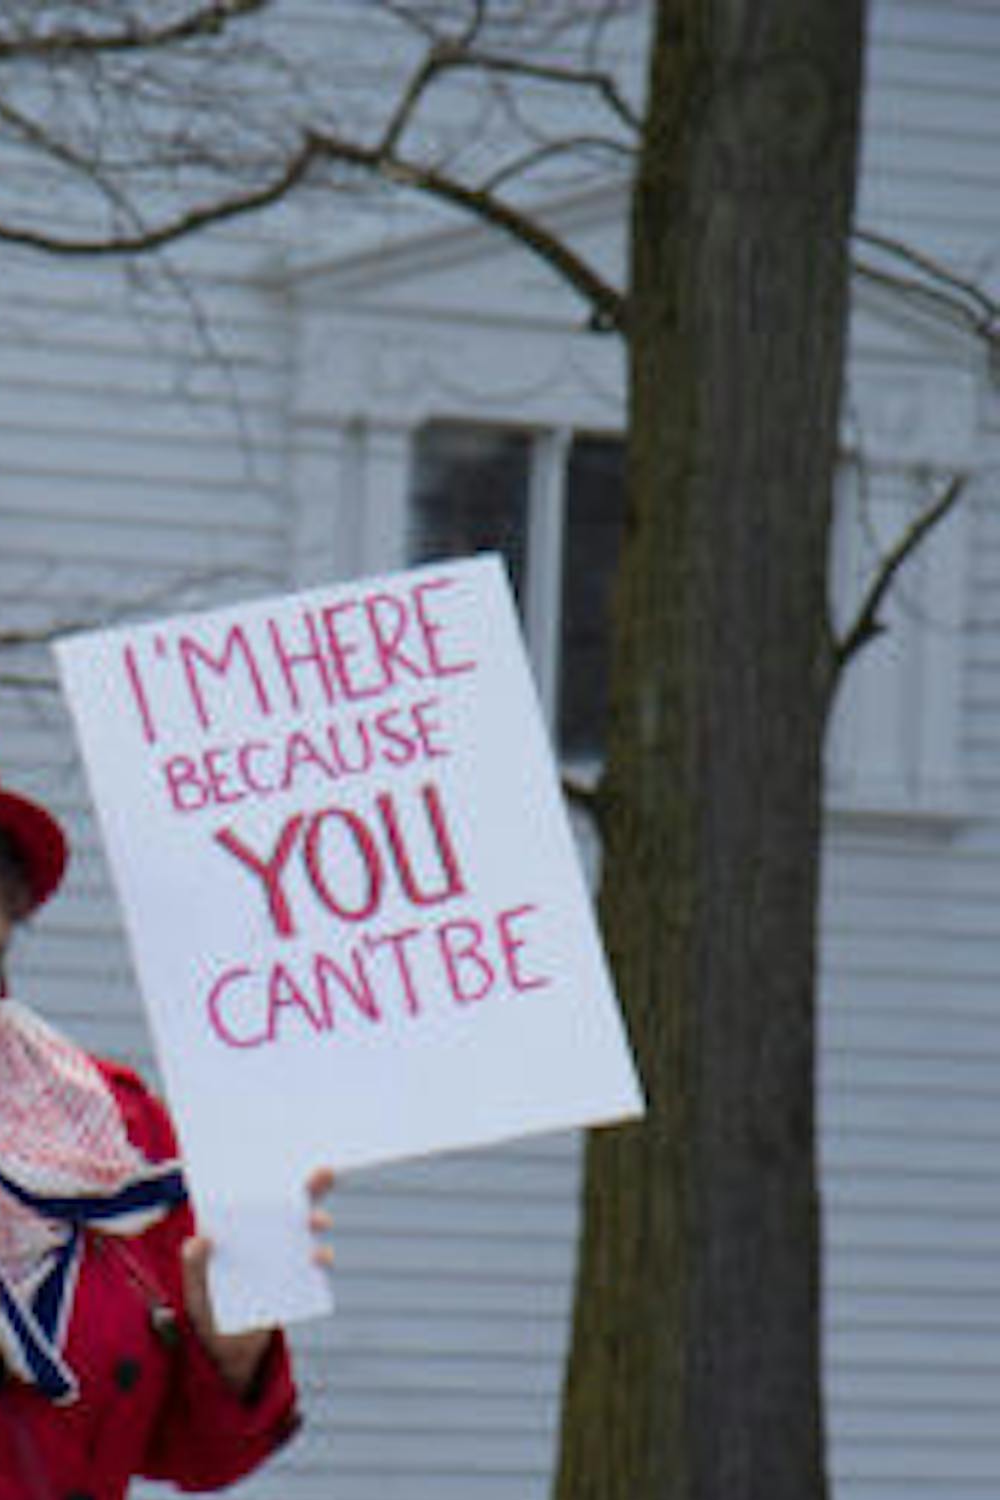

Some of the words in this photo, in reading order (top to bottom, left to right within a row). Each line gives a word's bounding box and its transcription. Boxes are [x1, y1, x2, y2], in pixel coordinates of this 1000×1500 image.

[123, 624, 272, 743] I'M
[266, 578, 476, 710] HERE
[163, 701, 452, 812] BECAUSE
[214, 783, 466, 940] YOU
[205, 927, 422, 1050] CAN'T
[437, 904, 550, 1005] BE
